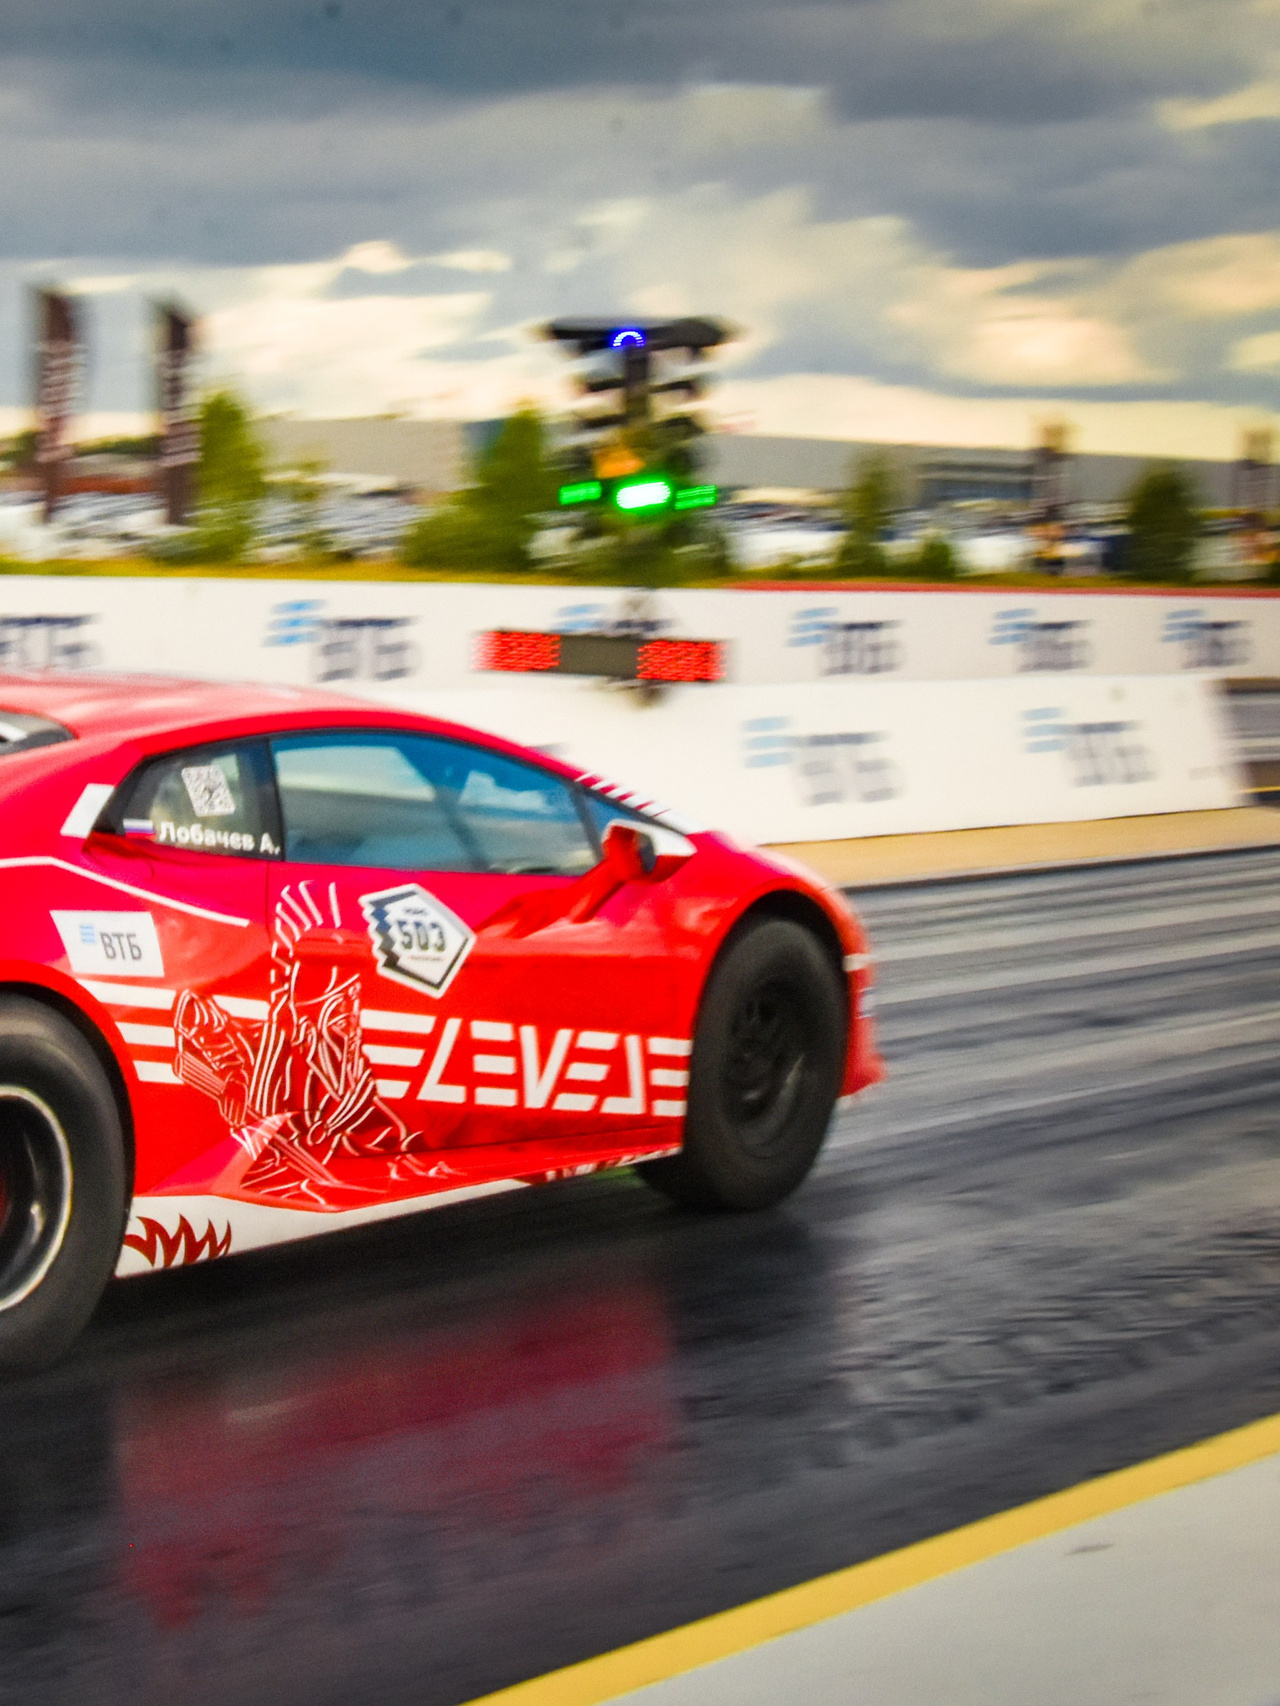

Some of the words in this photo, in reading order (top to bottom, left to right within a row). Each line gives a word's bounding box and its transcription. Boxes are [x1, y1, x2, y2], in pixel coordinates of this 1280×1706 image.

[158, 820, 255, 851] Лобачев
[99, 931, 143, 961] ВТБ
[397, 920, 446, 952] 503
